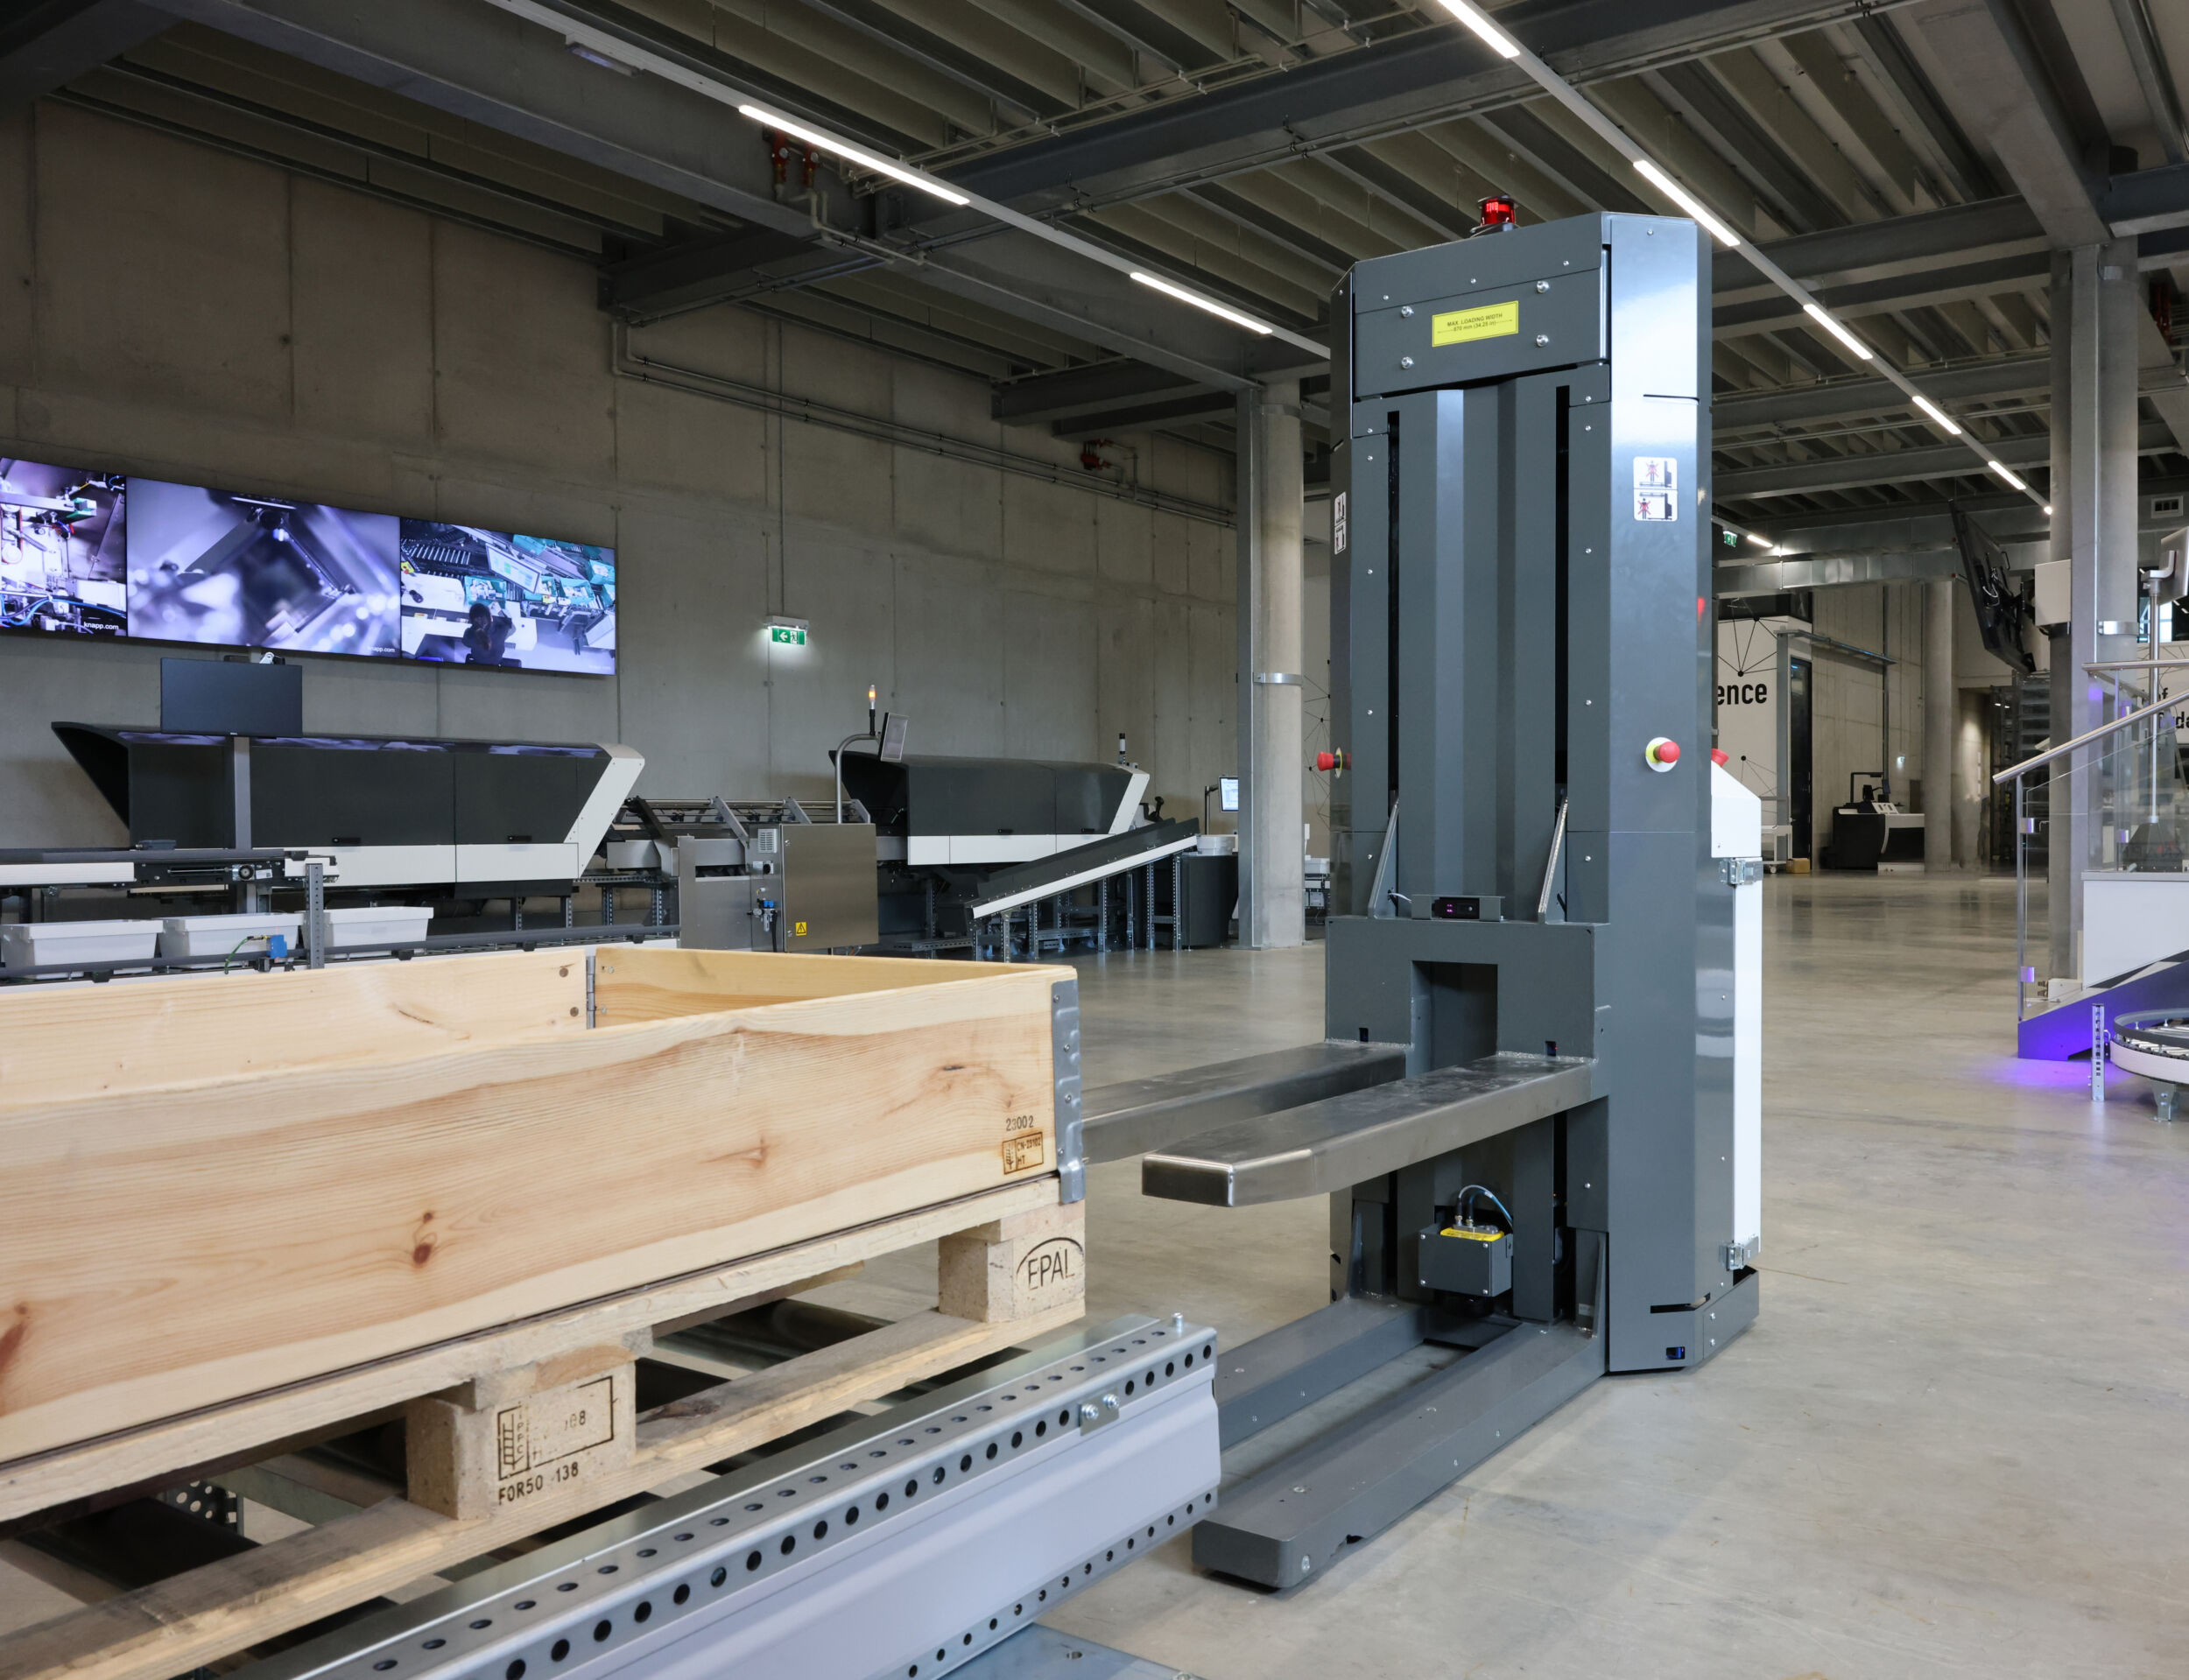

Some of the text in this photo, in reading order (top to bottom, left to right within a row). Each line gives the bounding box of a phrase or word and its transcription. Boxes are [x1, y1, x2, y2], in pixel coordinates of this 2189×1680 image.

[1461, 316, 1484, 325] LOADING
[83, 622, 119, 630] knapp.com
[1717, 684, 1768, 706] ence
[1005, 1115, 1034, 1132] 23002
[1028, 1248, 1076, 1291] EPAL
[498, 1461, 579, 1506] FOR50 138
